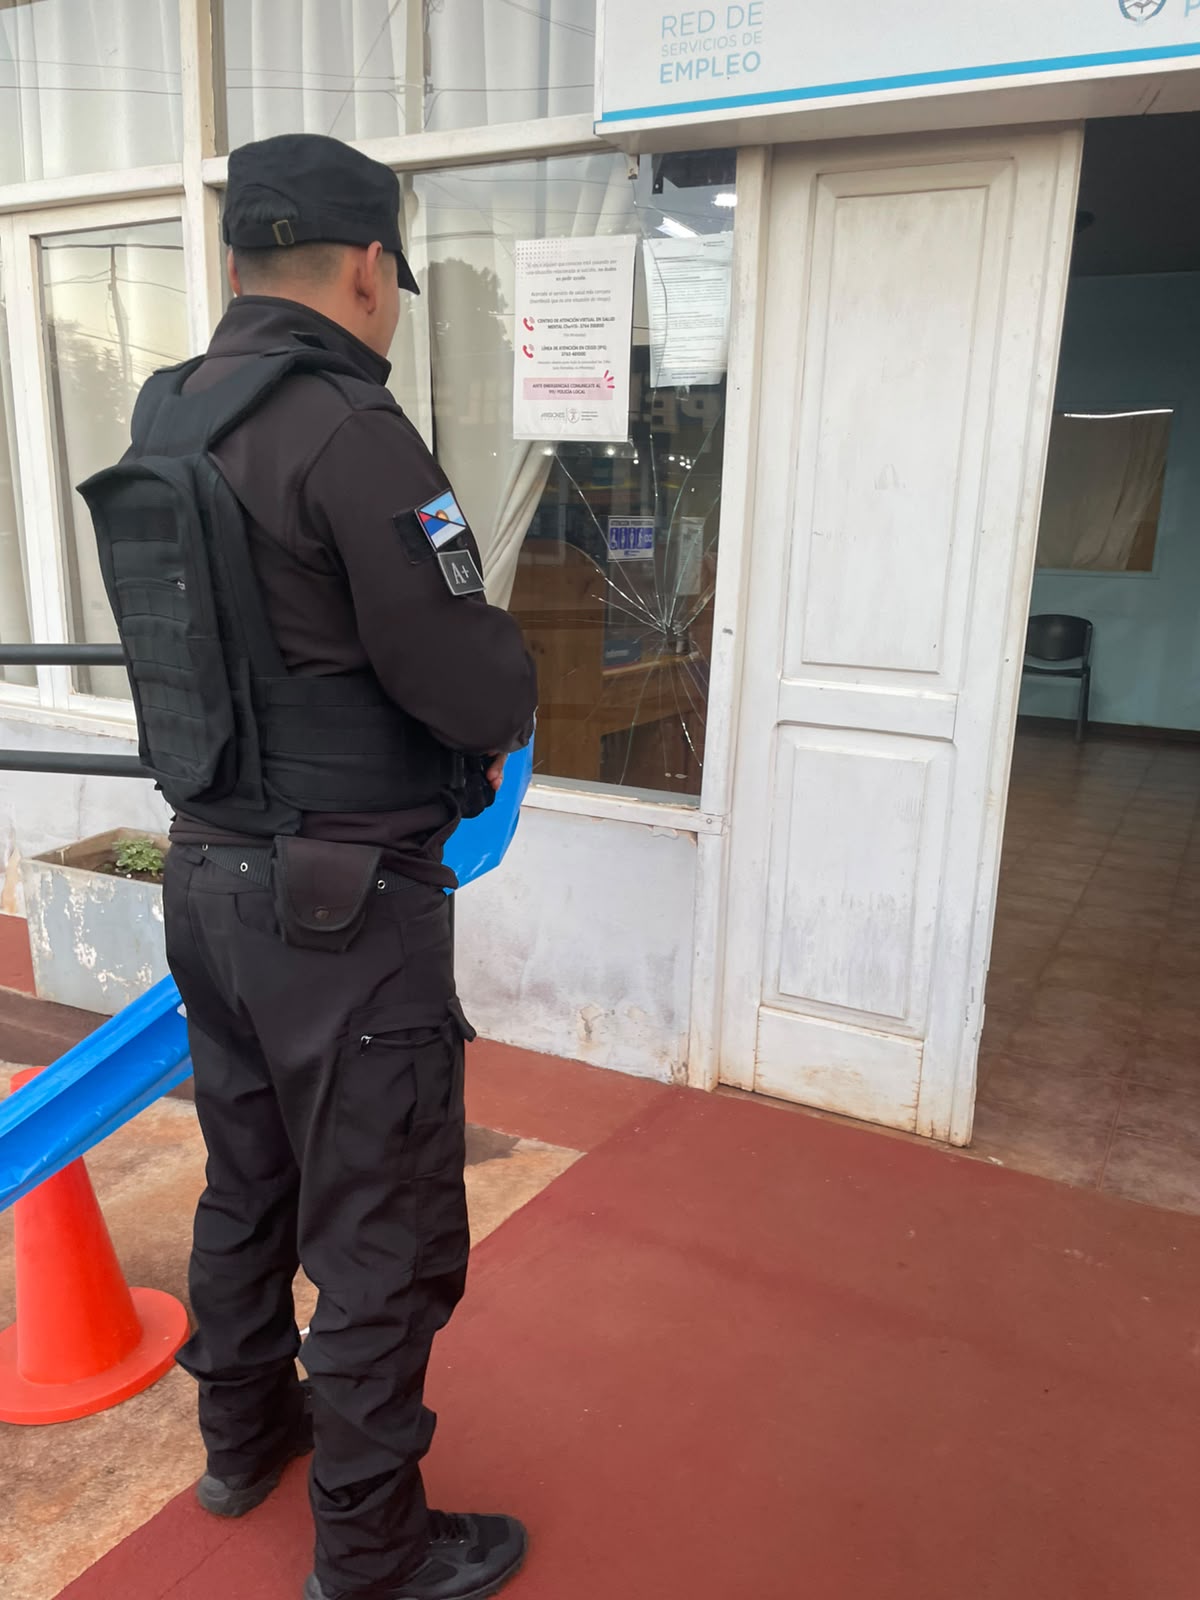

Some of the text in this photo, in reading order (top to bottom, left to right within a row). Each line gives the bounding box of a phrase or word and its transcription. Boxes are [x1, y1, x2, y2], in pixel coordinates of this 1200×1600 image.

[661, 1, 764, 39] RED DE
[661, 30, 762, 58] SERVICIOS DE
[659, 50, 761, 84] EMPLEO
[451, 562, 470, 585] A+
